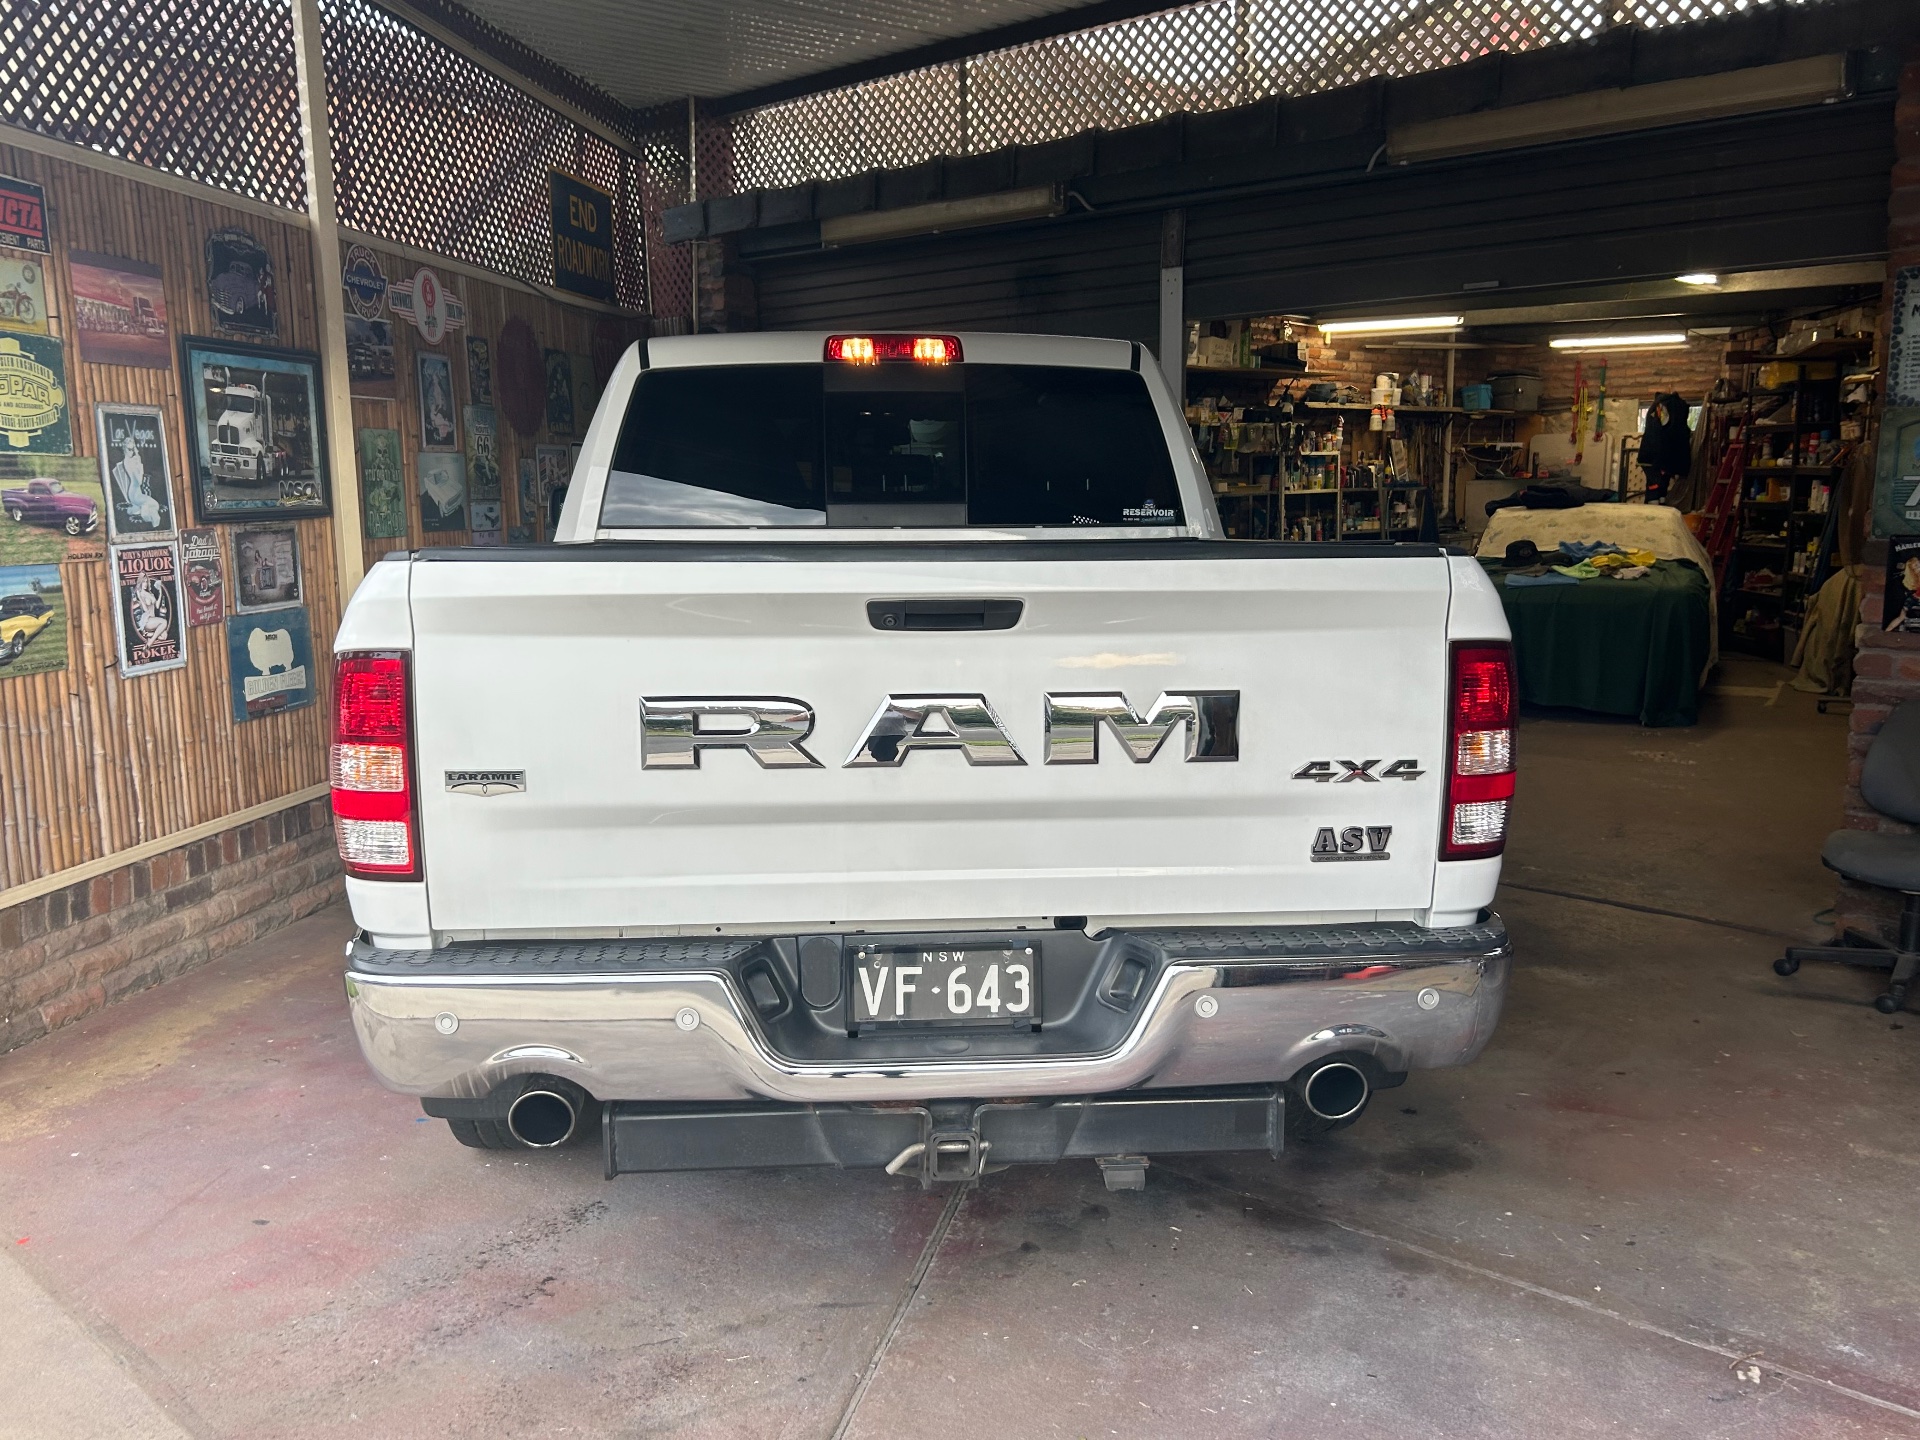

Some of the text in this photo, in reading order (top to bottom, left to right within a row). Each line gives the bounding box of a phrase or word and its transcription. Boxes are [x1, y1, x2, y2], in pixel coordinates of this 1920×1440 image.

[570, 195, 597, 232] END
[26, 237, 46, 251] PARTS
[351, 248, 377, 268] TRUCK
[557, 233, 611, 282] ROADWORK
[346, 275, 383, 290] CHEVROLET
[353, 294, 380, 317] SERVICE
[110, 418, 155, 444] Las Vegas
[476, 426, 490, 434] ROUTE
[476, 436, 490, 456] 66
[1123, 508, 1174, 516] RESERVOIR
[183, 544, 220, 564] Garage
[119, 557, 174, 573] LIQUOR
[133, 644, 177, 660] POKER
[247, 677, 278, 696] GOLDEN
[640, 689, 1240, 770] RAM
[448, 773, 521, 781] LARAMIE
[1290, 759, 1427, 783] 4X4
[1311, 825, 1393, 854] ASV
